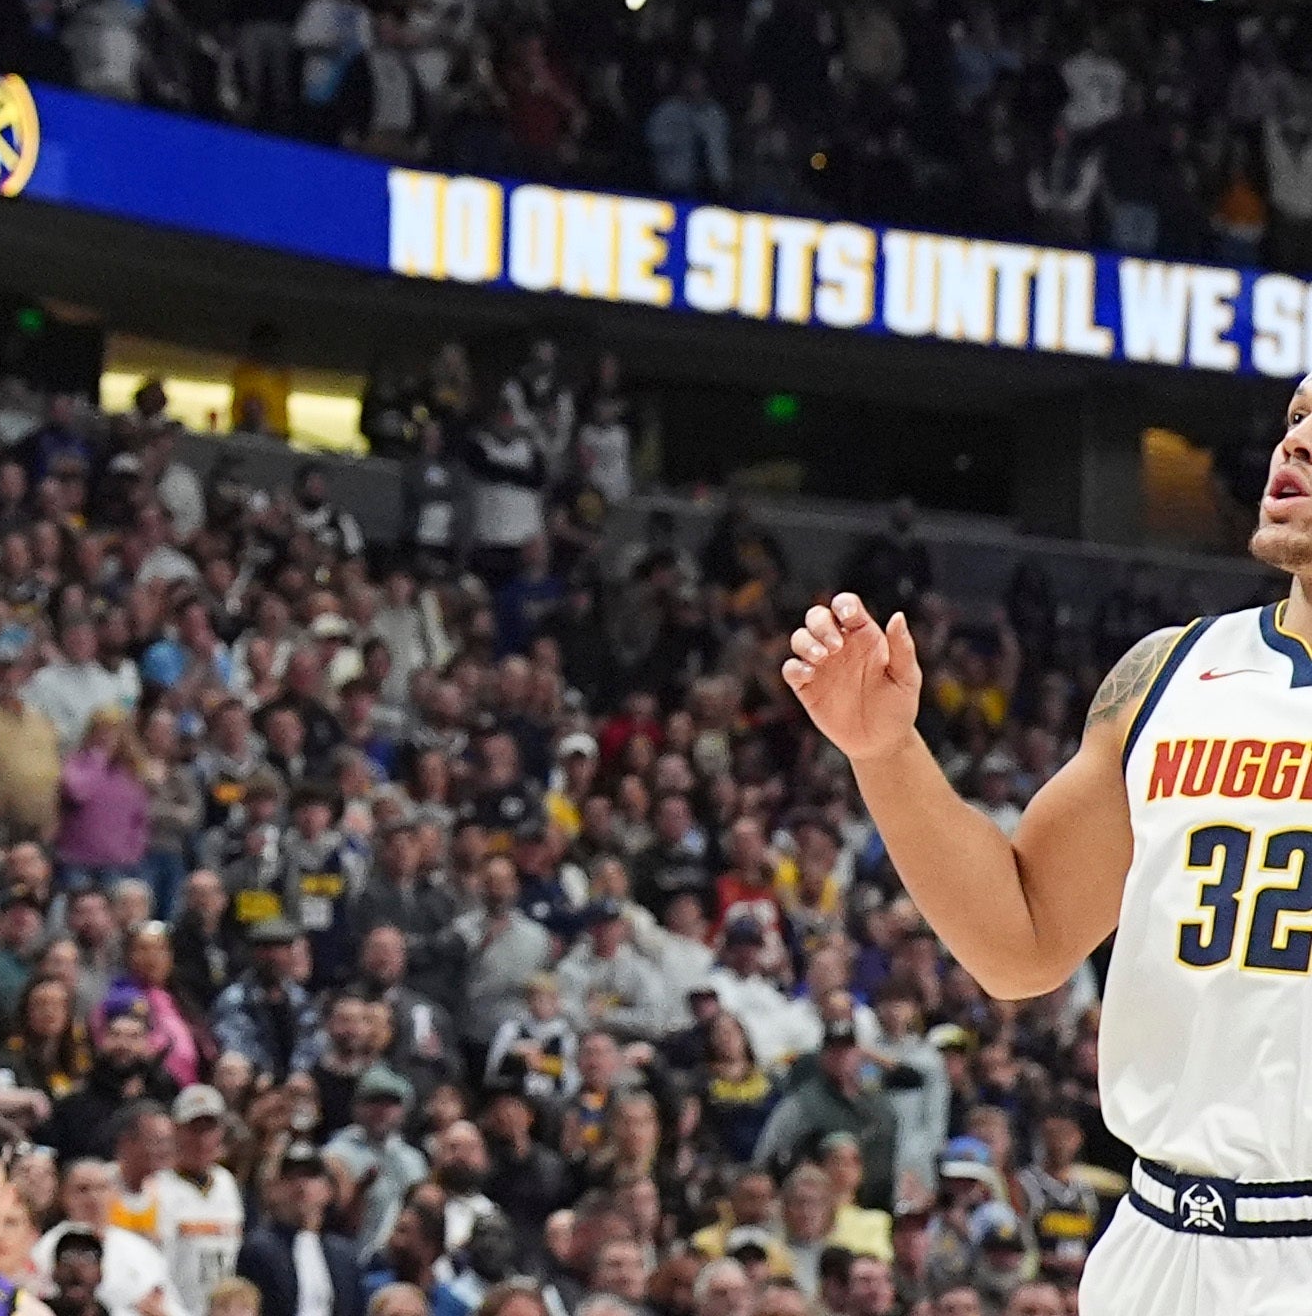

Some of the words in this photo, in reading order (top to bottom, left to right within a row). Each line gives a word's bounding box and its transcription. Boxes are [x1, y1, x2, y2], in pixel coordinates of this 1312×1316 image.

[387, 167, 504, 283] NO
[507, 184, 675, 306] ONE
[684, 205, 876, 328] SITS
[881, 230, 1115, 358] UNTIL
[1119, 255, 1242, 373] WE
[1251, 272, 1312, 379] S
[1175, 820, 1312, 977] 32
